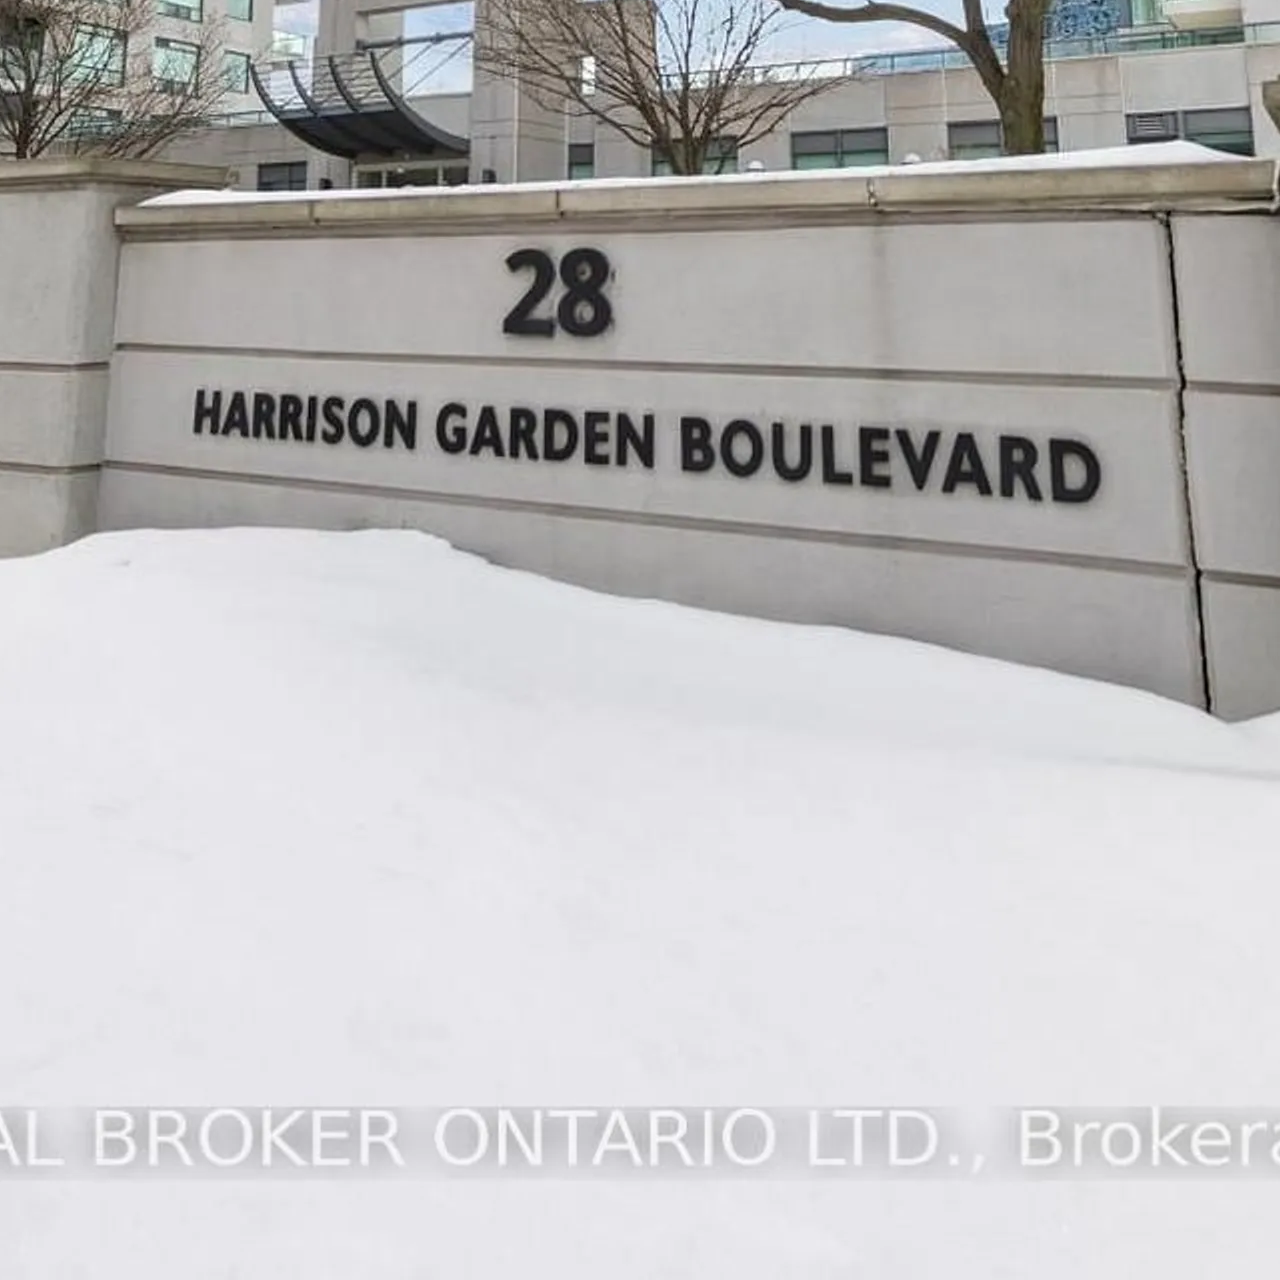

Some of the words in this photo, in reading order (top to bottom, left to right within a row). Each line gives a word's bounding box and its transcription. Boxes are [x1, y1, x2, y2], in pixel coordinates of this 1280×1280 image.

[503, 247, 612, 338] 28
[193, 389, 418, 450] HARRISON
[435, 402, 656, 469] GARDEN
[680, 416, 1102, 504] BOULEVARD
